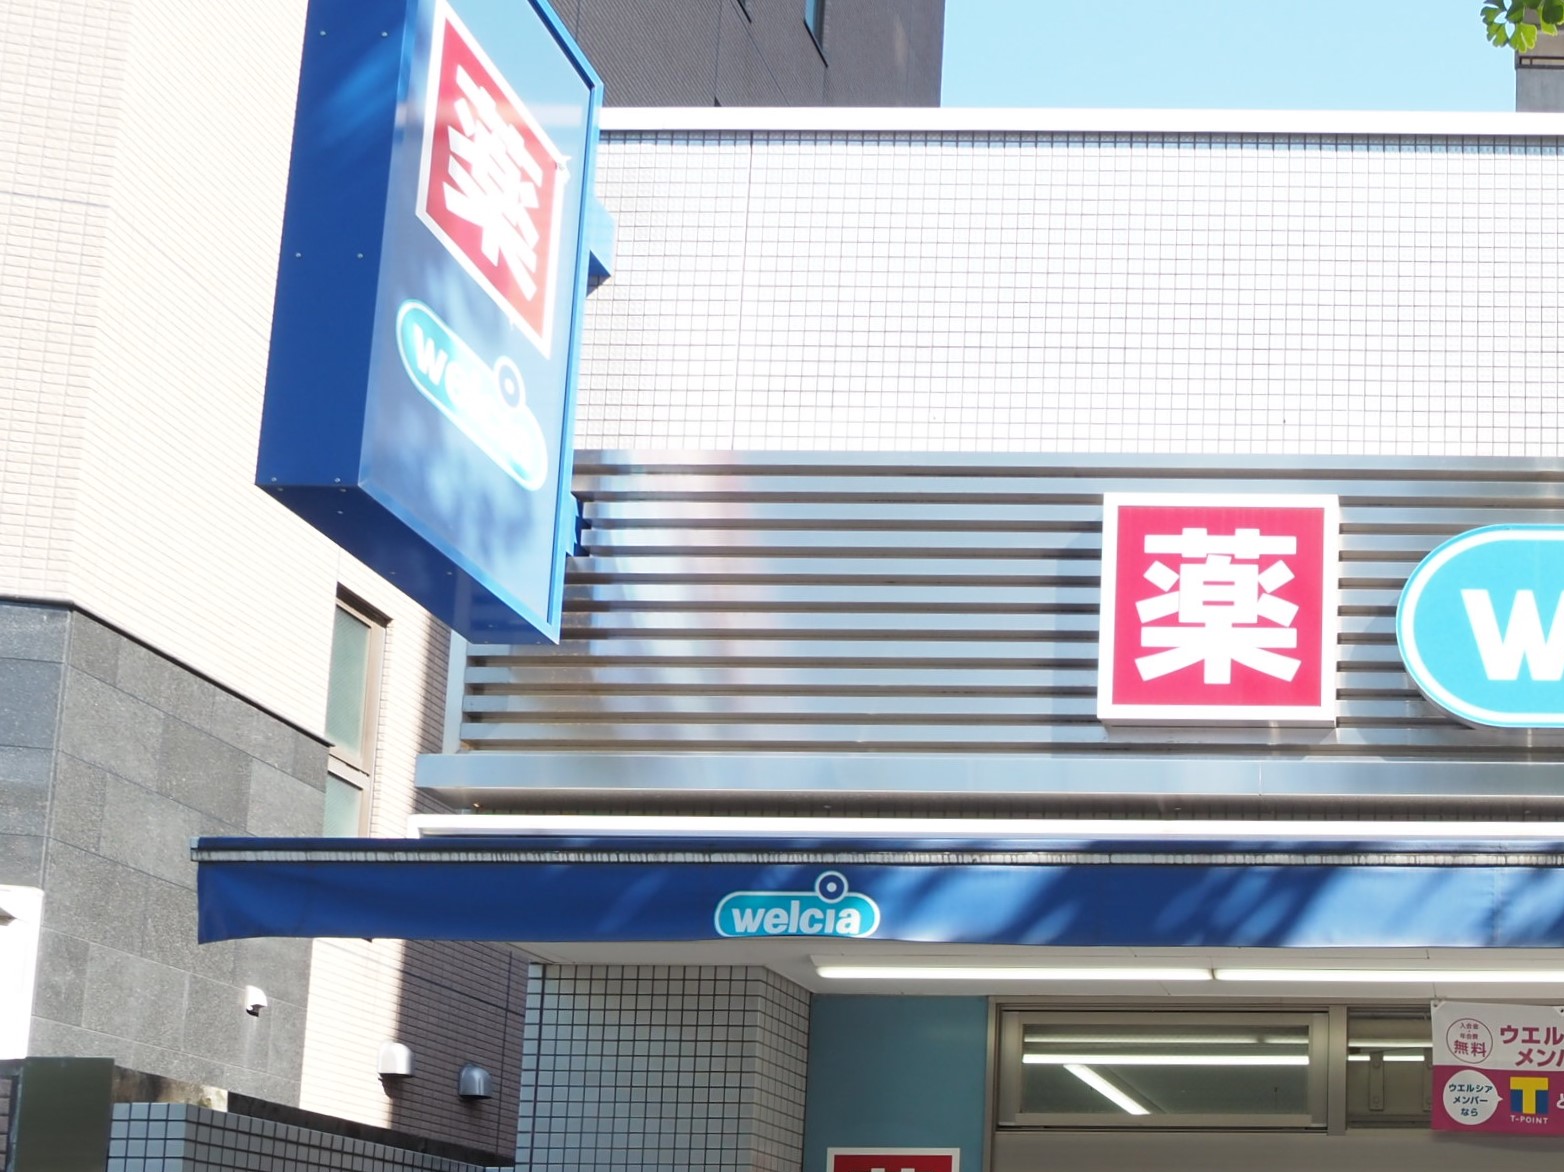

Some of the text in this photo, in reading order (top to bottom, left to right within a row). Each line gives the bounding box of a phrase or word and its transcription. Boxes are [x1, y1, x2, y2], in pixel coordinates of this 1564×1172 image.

[442, 63, 542, 302] 薬
[1135, 527, 1302, 685] 薬
[731, 888, 862, 935] welcia
[1453, 1039, 1487, 1058] 無料
[1448, 1083, 1493, 1094] ウエルシア
[1452, 1095, 1488, 1104] メンバー
[1460, 1107, 1479, 1117] なら
[1510, 1115, 1549, 1125] T-POINT
